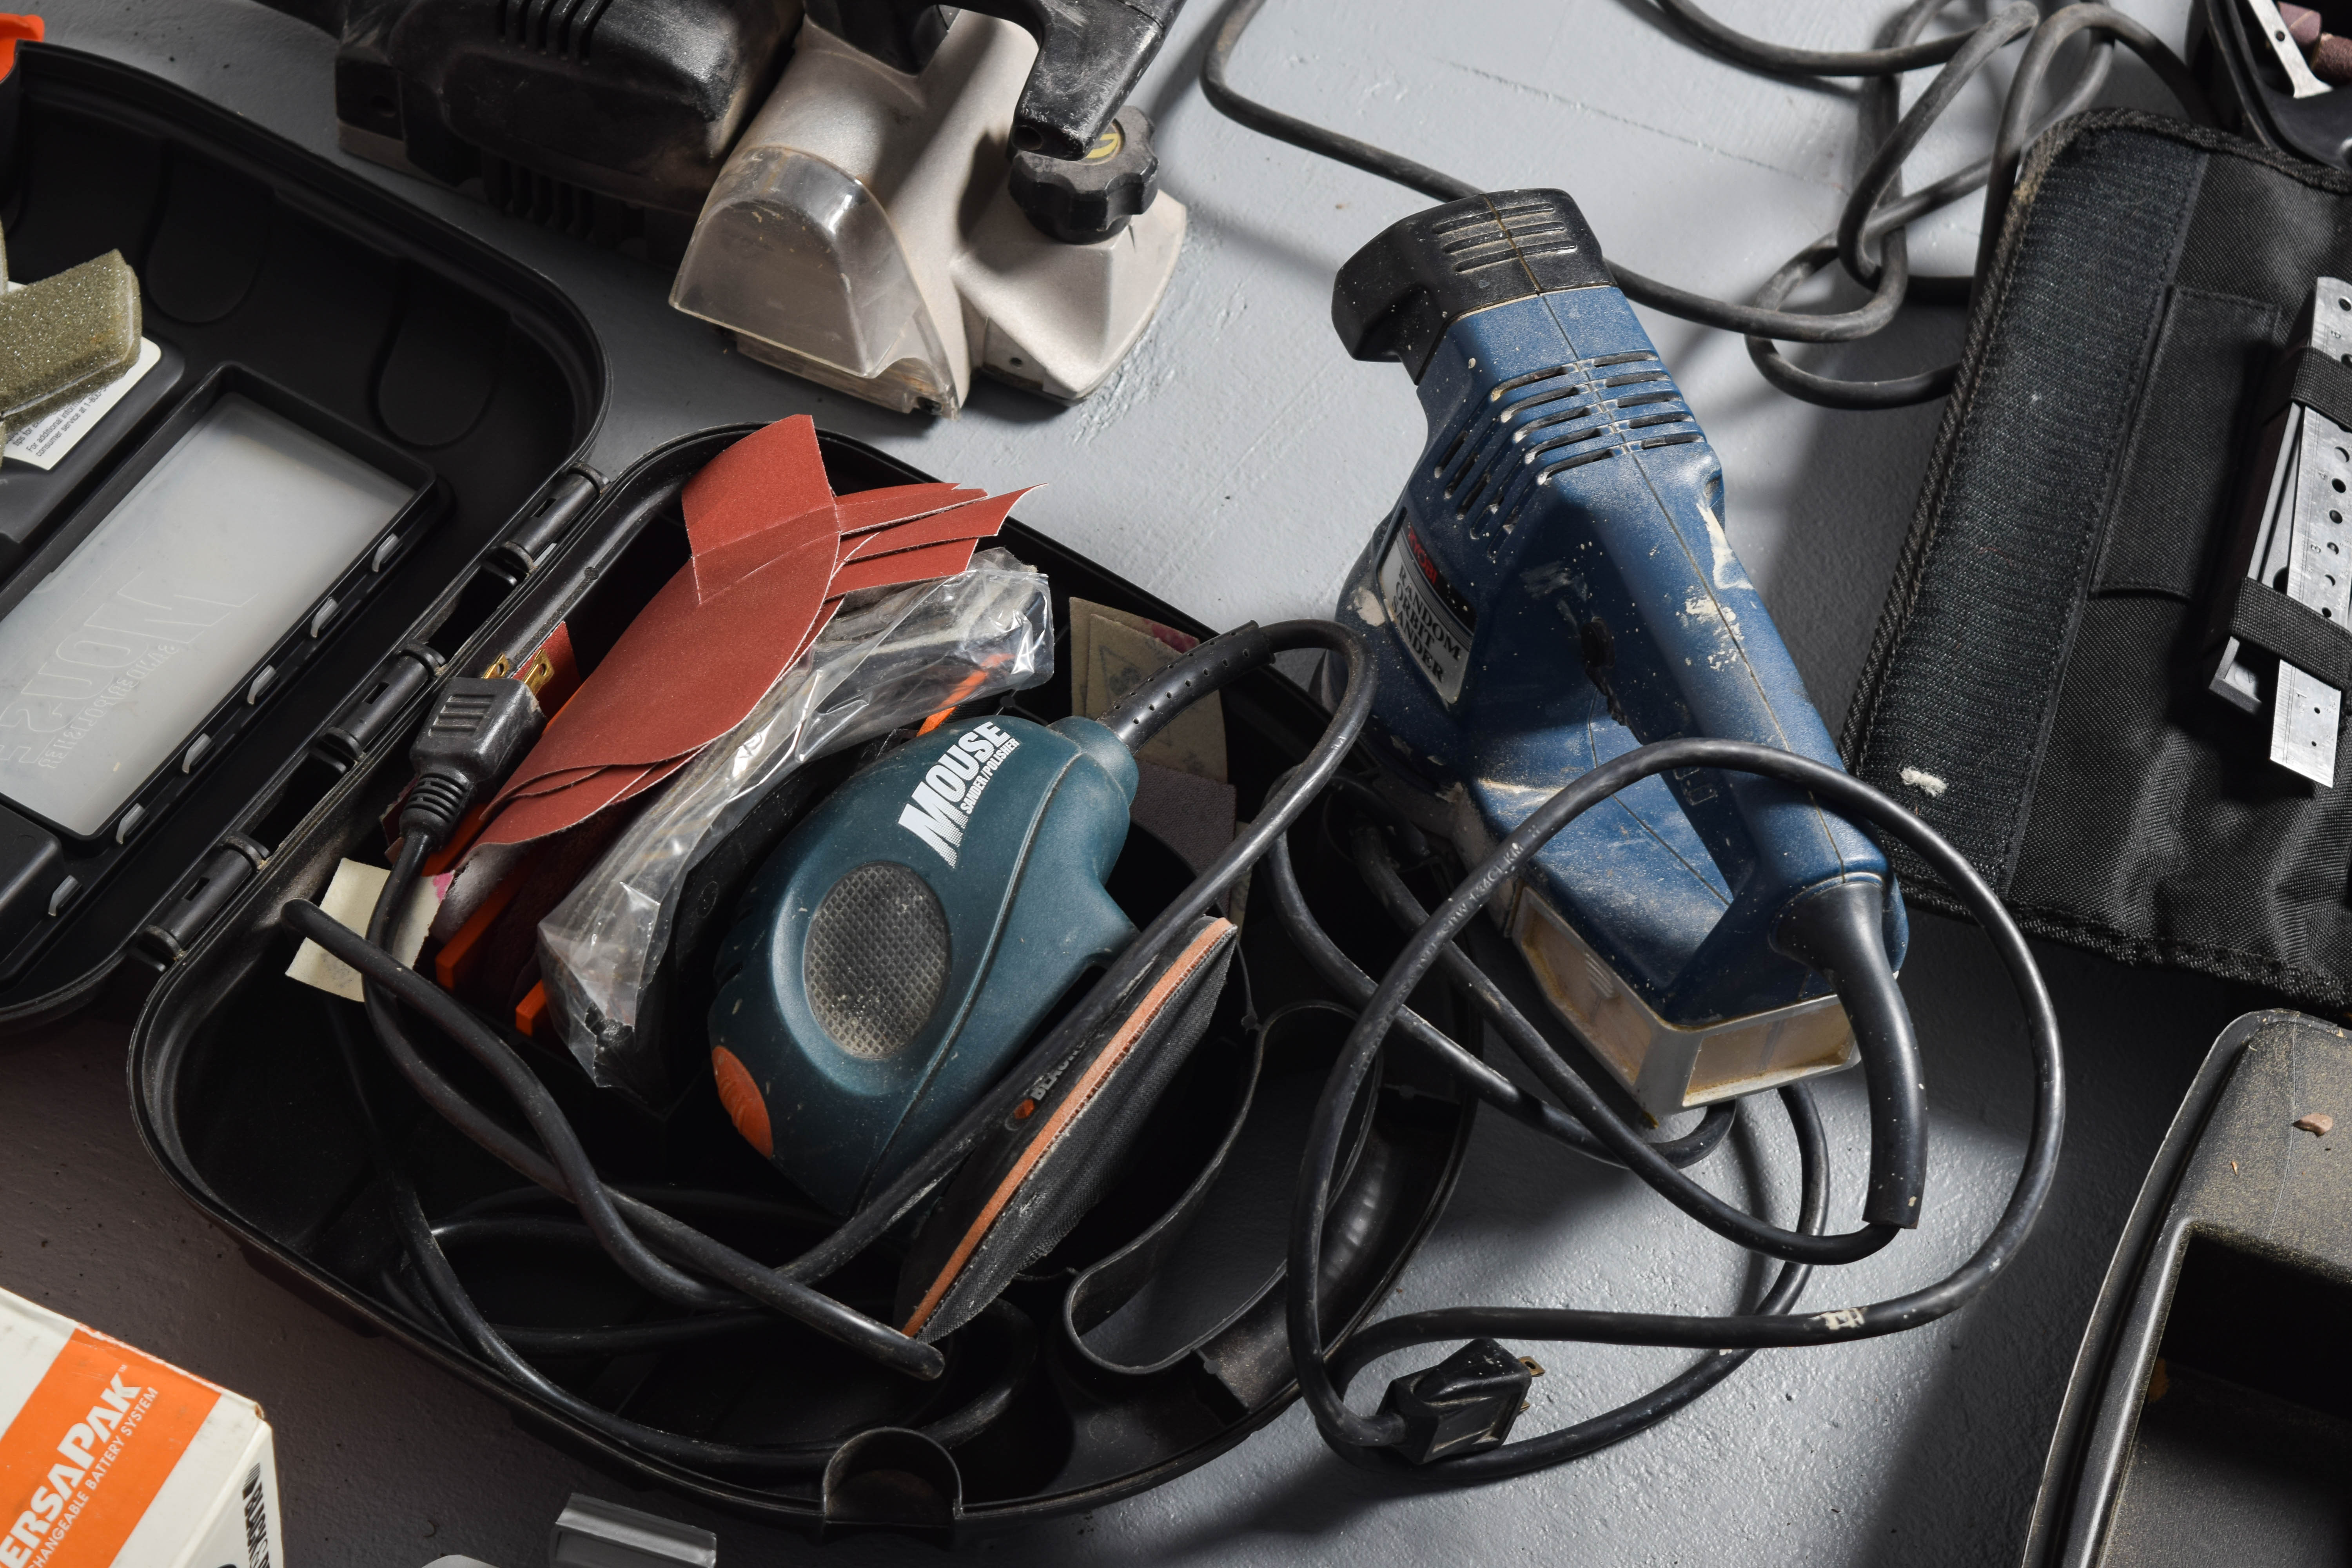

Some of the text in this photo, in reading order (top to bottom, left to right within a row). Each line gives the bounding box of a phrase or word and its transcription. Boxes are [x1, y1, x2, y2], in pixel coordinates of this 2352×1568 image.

[13, 427, 33, 446] tips for
[26, 442, 38, 452] For
[37, 416, 63, 443] additional
[36, 430, 62, 456] consumer
[61, 412, 81, 431] service
[1408, 526, 1437, 584] RYOBI
[1391, 595, 1444, 684] SANDER
[1396, 581, 1435, 647] ORBIT
[1399, 563, 1461, 661] RANDOM
[898, 721, 1011, 869] MOUSE
[960, 737, 1020, 815] SANDER/POLISHER
[87, 1437, 125, 1490] BATTERY
[122, 1386, 159, 1437] SYSTEM
